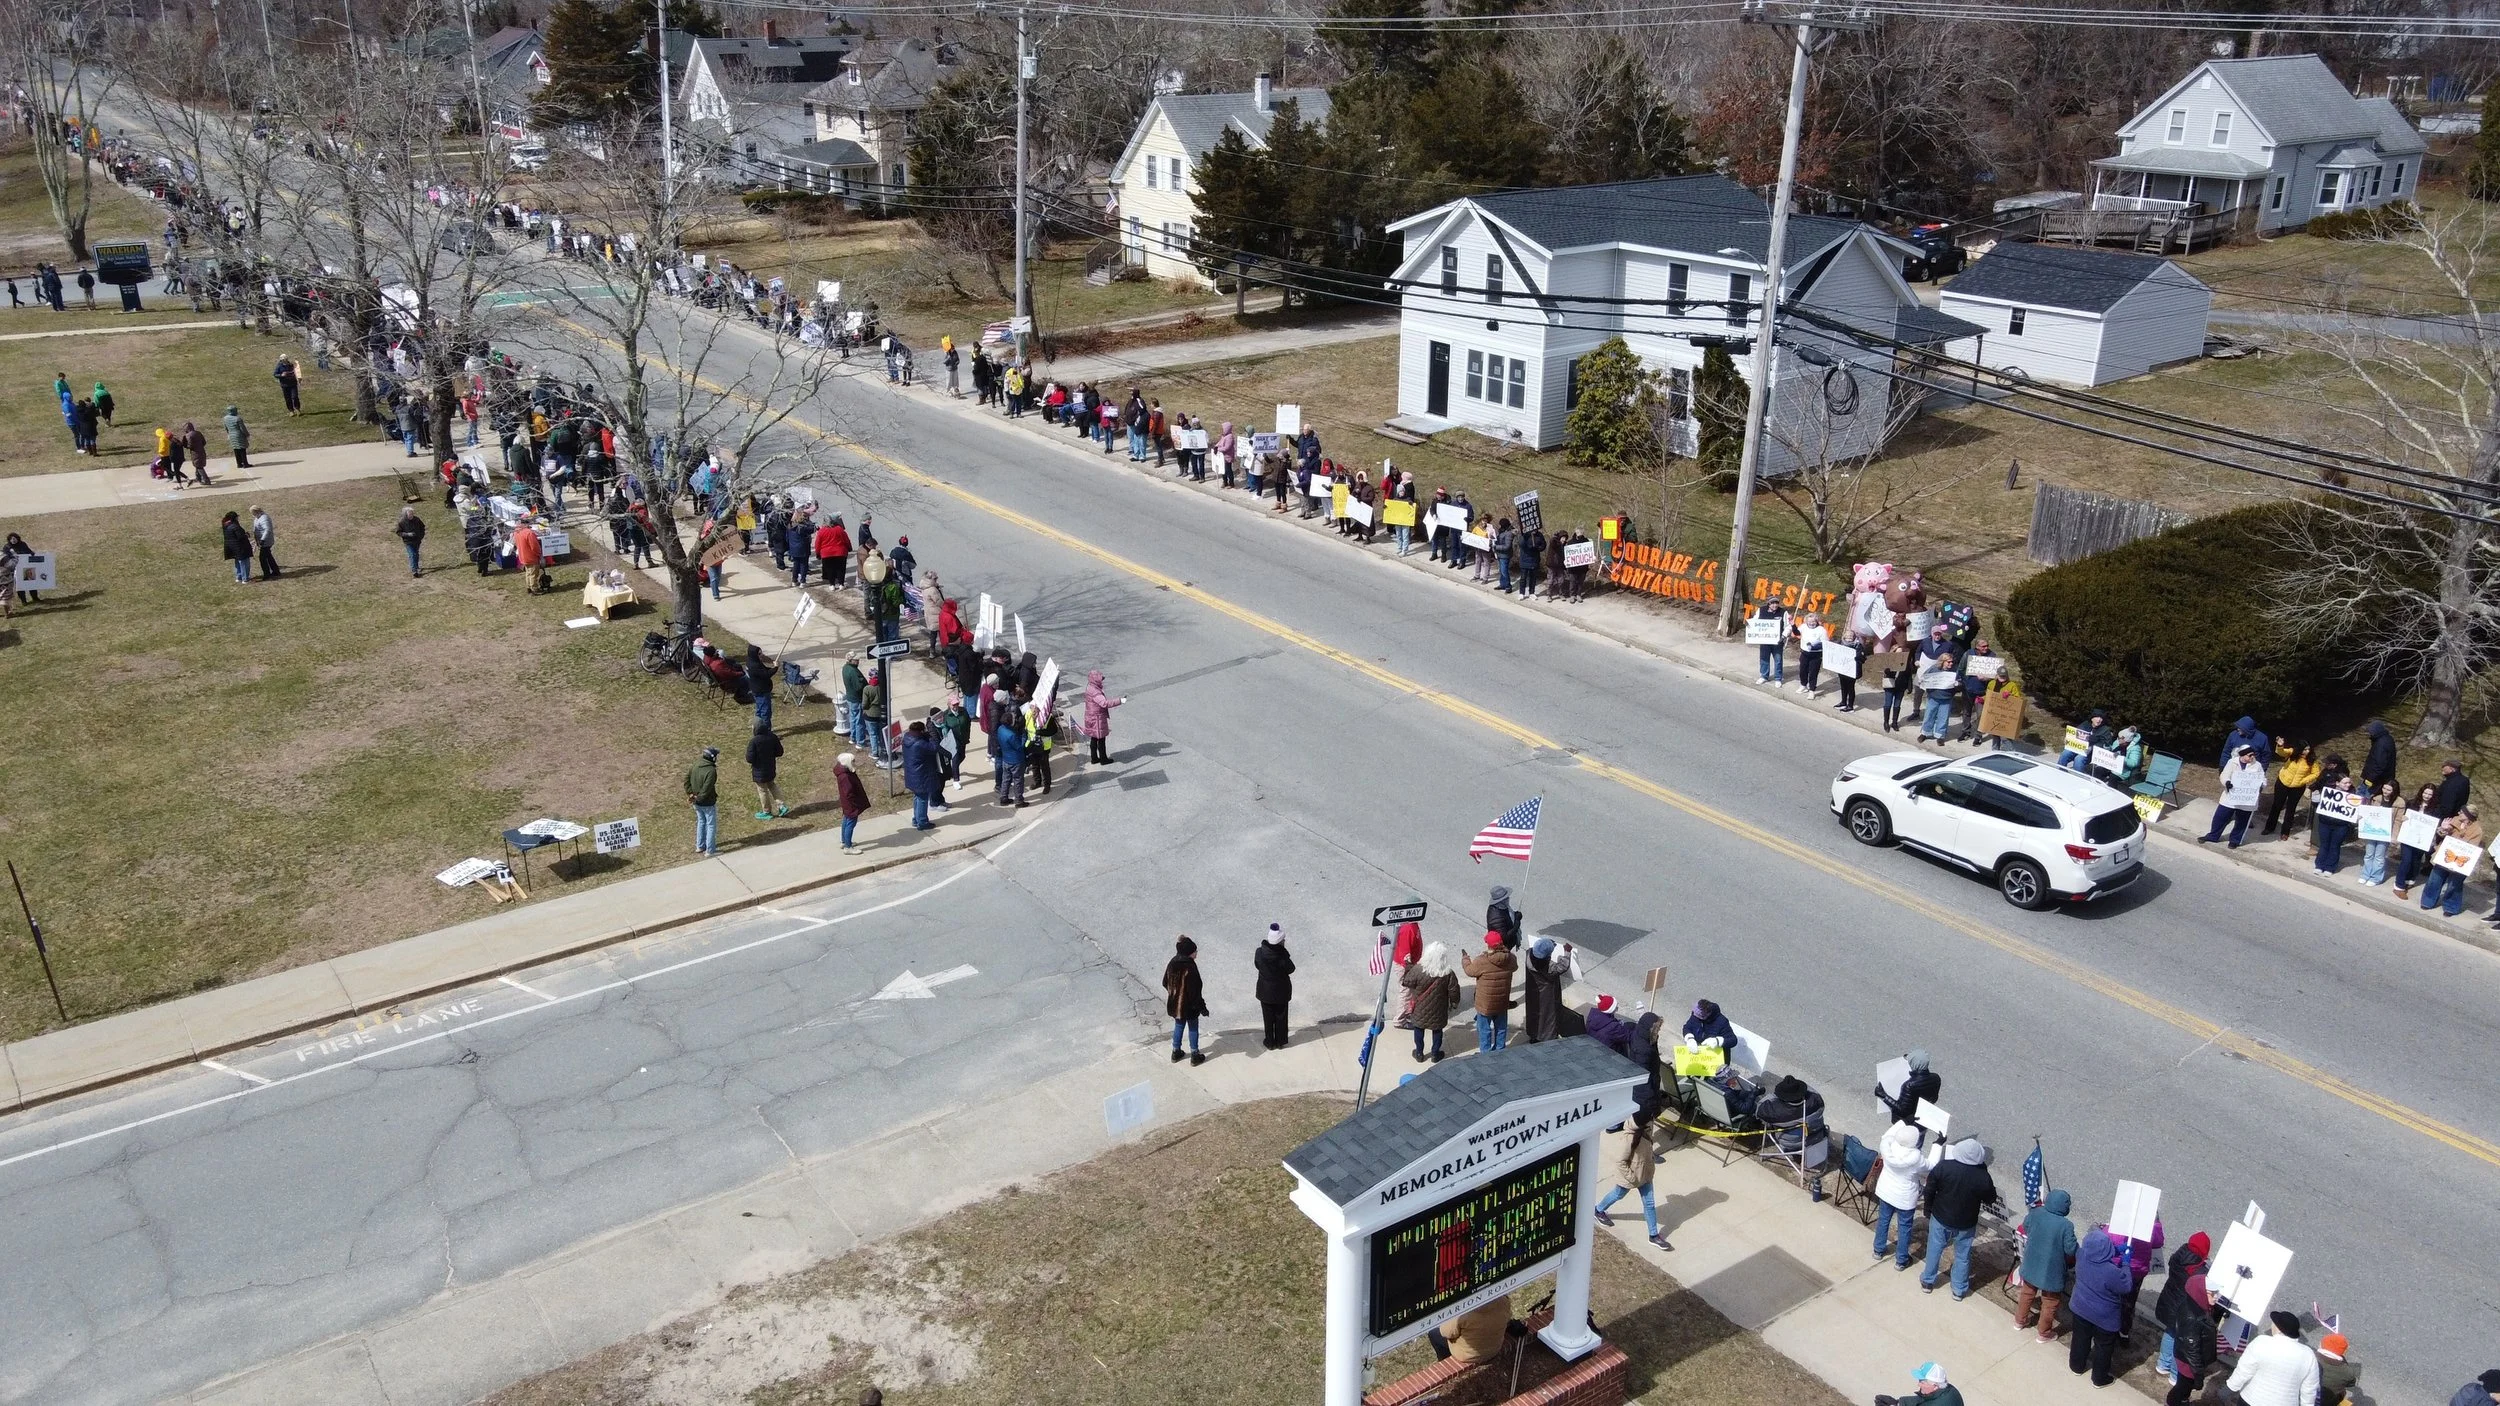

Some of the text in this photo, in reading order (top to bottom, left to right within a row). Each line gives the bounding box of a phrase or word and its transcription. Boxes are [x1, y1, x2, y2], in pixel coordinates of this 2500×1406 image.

[97, 245, 144, 255] WAREHAM
[711, 544, 734, 560] KING
[1565, 548, 1583, 557] PEOPLE
[1566, 553, 1594, 565] ENOUGH
[1611, 540, 1719, 581] COURAGE IS
[1610, 562, 1716, 603] CONTAGIOUS
[1753, 576, 1837, 615] RESIST
[879, 646, 892, 654] ONE
[2066, 727, 2076, 736] NO
[2065, 740, 2087, 750] KINGS
[2323, 788, 2344, 802] NO
[2320, 799, 2357, 818] KINGS!
[599, 825, 635, 837] US-ISRAELI
[597, 834, 623, 843] ILLEGAL
[605, 837, 632, 847] AGAINST
[1389, 908, 1421, 919] ONE WAY
[295, 999, 484, 1062] FIRE LANE
[1468, 1115, 1526, 1146] WAREHAM
[1379, 1098, 1603, 1206] MEMORIAL TOWN HALL
[1437, 1295, 1483, 1321] MARION
[1488, 1278, 1517, 1296] ROAD
